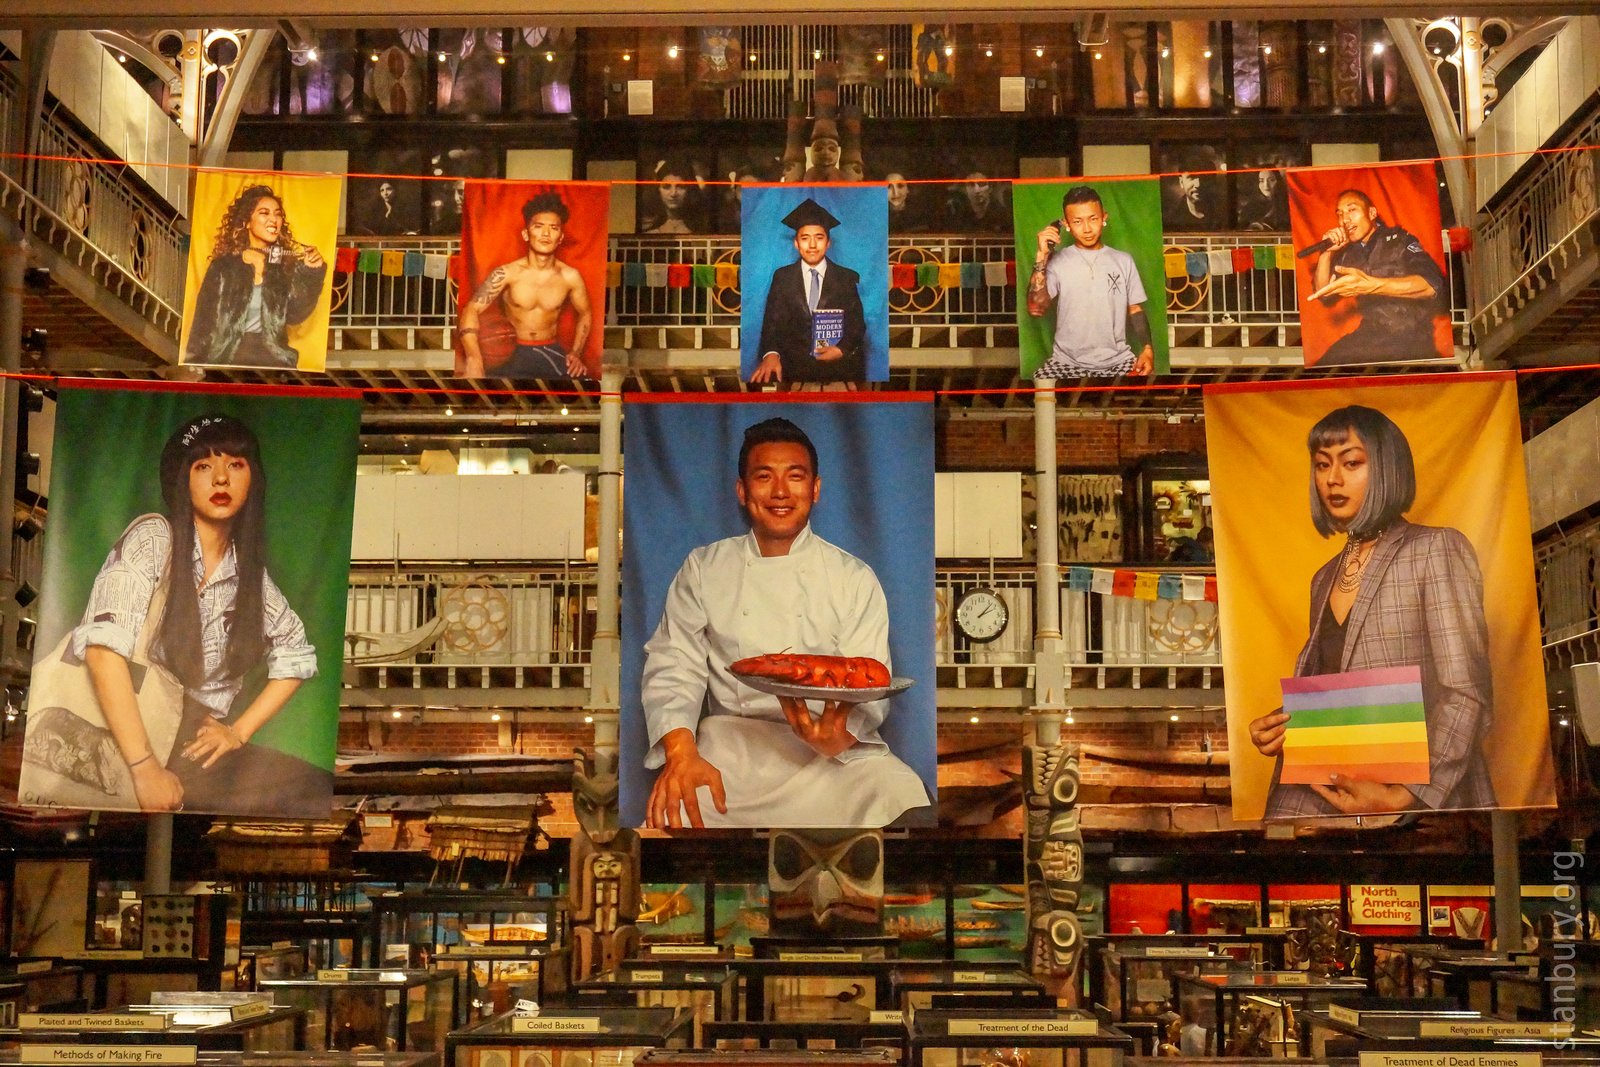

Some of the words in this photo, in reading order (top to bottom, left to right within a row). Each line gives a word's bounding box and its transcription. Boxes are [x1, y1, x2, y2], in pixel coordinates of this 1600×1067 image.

[816, 330, 843, 339] TIBET
[1361, 886, 1397, 896] North
[1362, 897, 1420, 908] American
[1362, 908, 1412, 922] Clothing
[1450, 1026, 1484, 1036] Religious
[1486, 1026, 1515, 1036] Figures
[53, 1050, 93, 1059] Methods
[97, 1050, 106, 1059] of
[109, 1050, 142, 1061] Making
[145, 1051, 163, 1059] Fire
[1383, 1056, 1434, 1067] Treatment
[1438, 1056, 1447, 1067] of
[1450, 1057, 1475, 1067] Dead
[1479, 1058, 1518, 1067] Enemies
